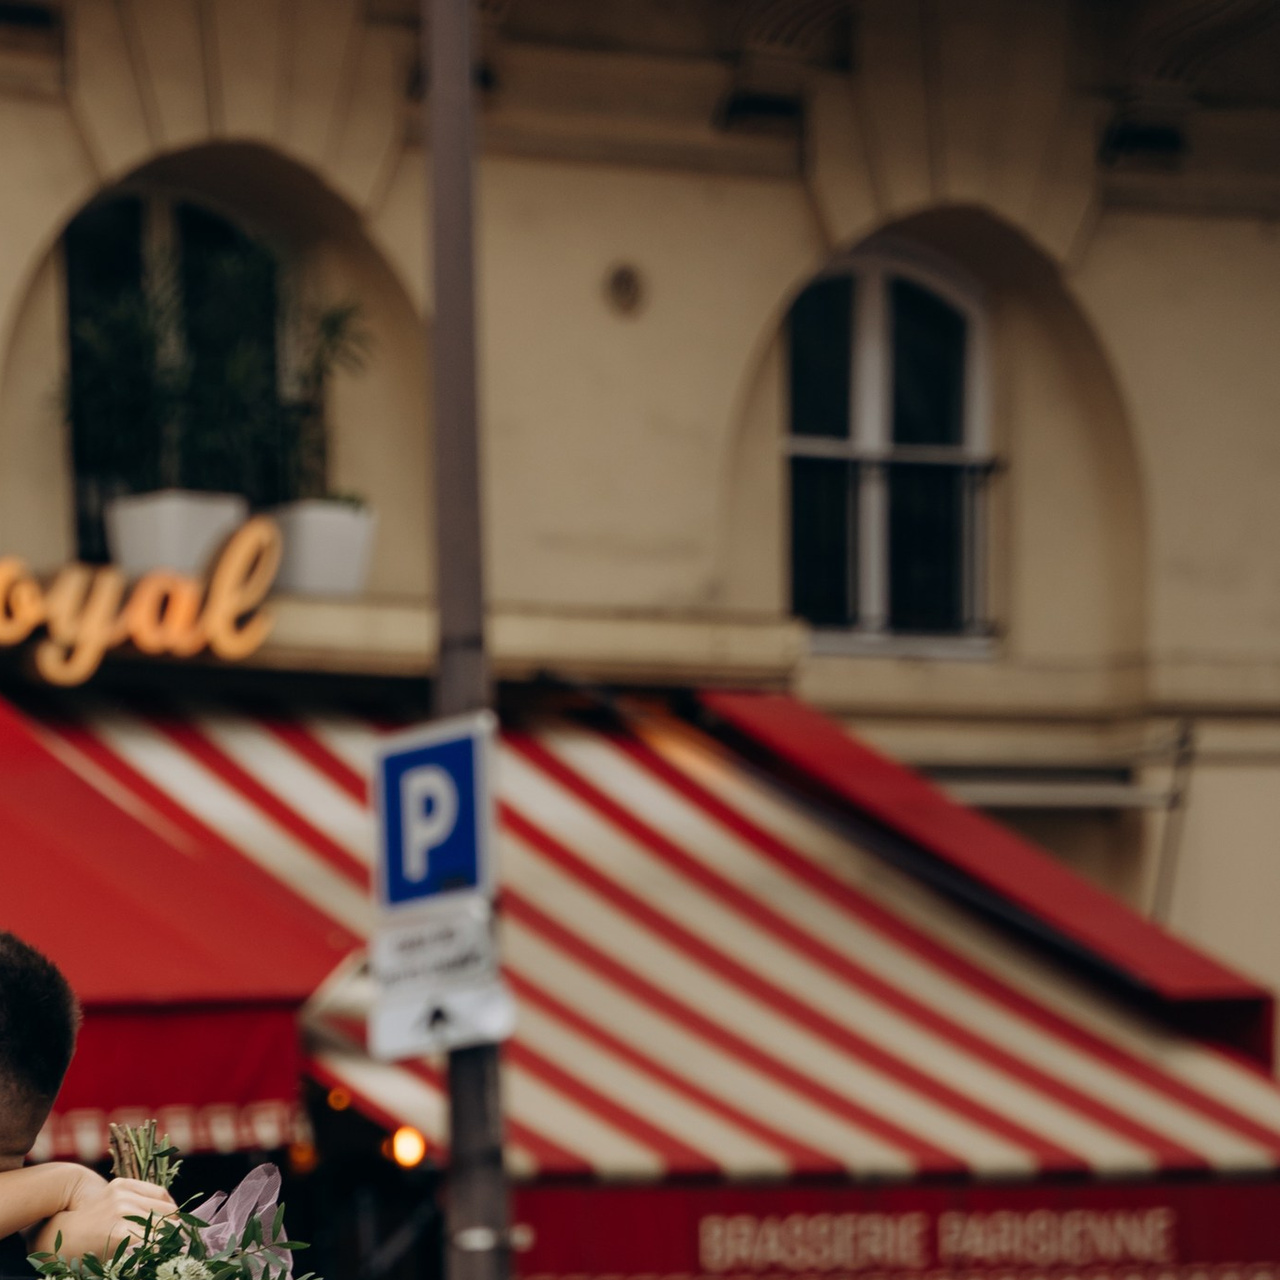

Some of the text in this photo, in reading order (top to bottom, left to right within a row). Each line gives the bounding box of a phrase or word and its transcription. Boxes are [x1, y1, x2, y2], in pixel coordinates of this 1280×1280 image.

[399, 763, 461, 883] P
[699, 1206, 1174, 1271] BRASSERIE PARISIENNE
